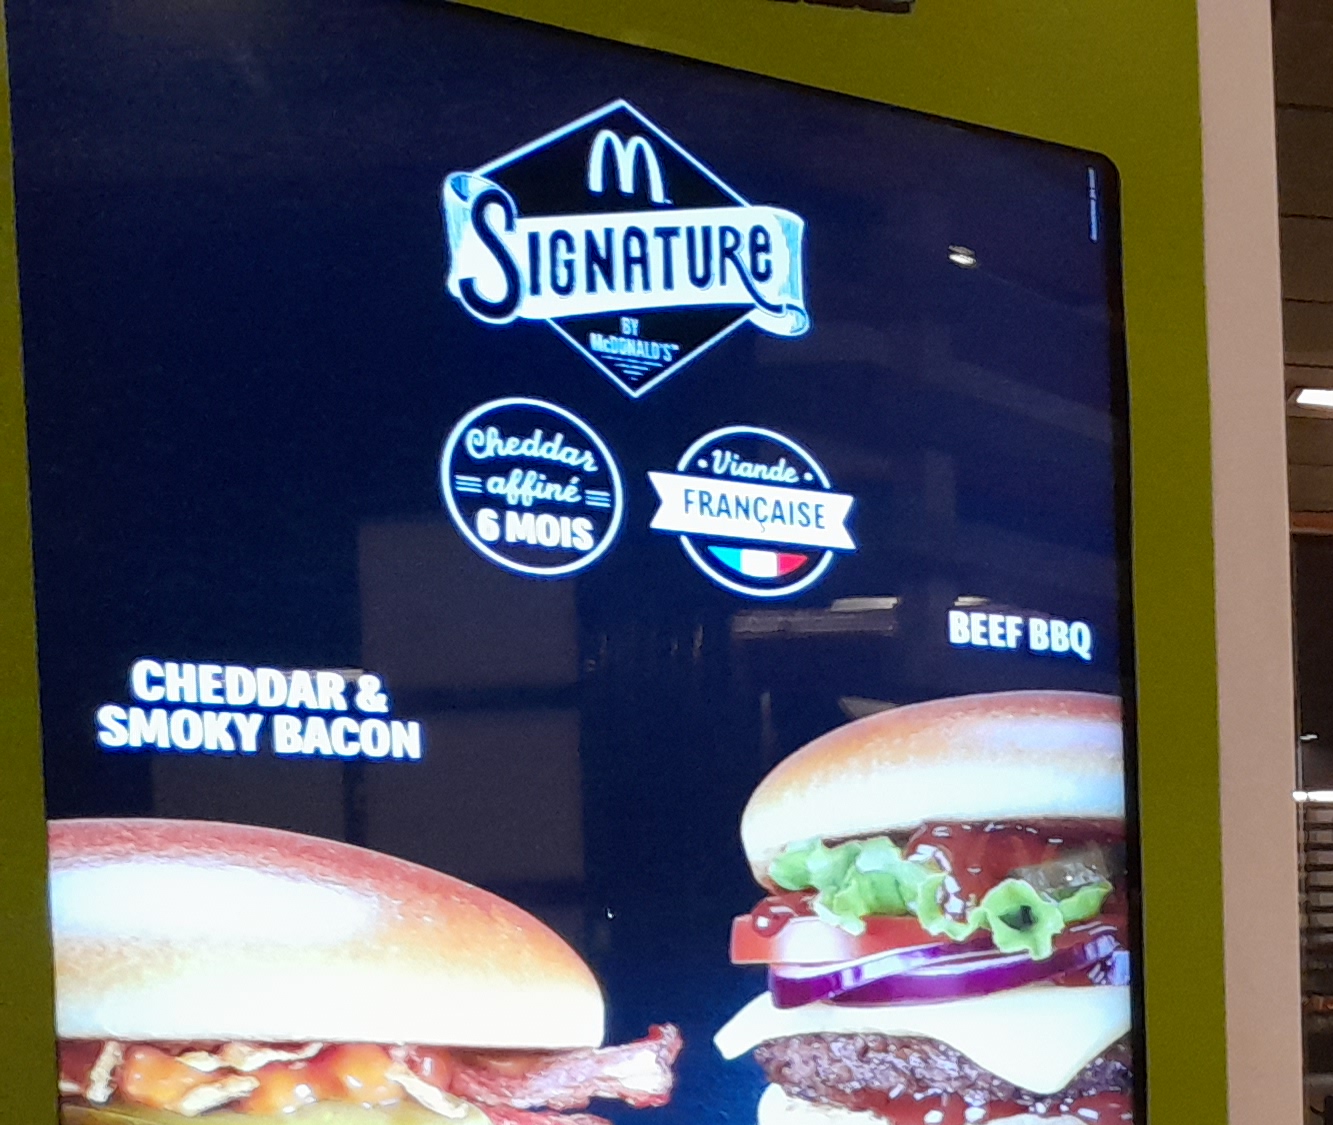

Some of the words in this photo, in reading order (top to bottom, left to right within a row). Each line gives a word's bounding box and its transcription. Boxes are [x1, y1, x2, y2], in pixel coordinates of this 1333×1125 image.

[620, 316, 639, 336] BY
[465, 427, 599, 472] Cheddar
[711, 449, 799, 483] Viande
[487, 475, 583, 507] affiné
[684, 489, 826, 532] FRANÇAISE
[476, 512, 500, 543] 6
[505, 514, 594, 551] MOIS
[948, 610, 1023, 649] BEEF
[1029, 617, 1092, 661] BBQ
[131, 658, 347, 711] CHEDDAR
[355, 674, 389, 713] &
[97, 705, 263, 753] SMOKY
[273, 717, 422, 760] BACON
